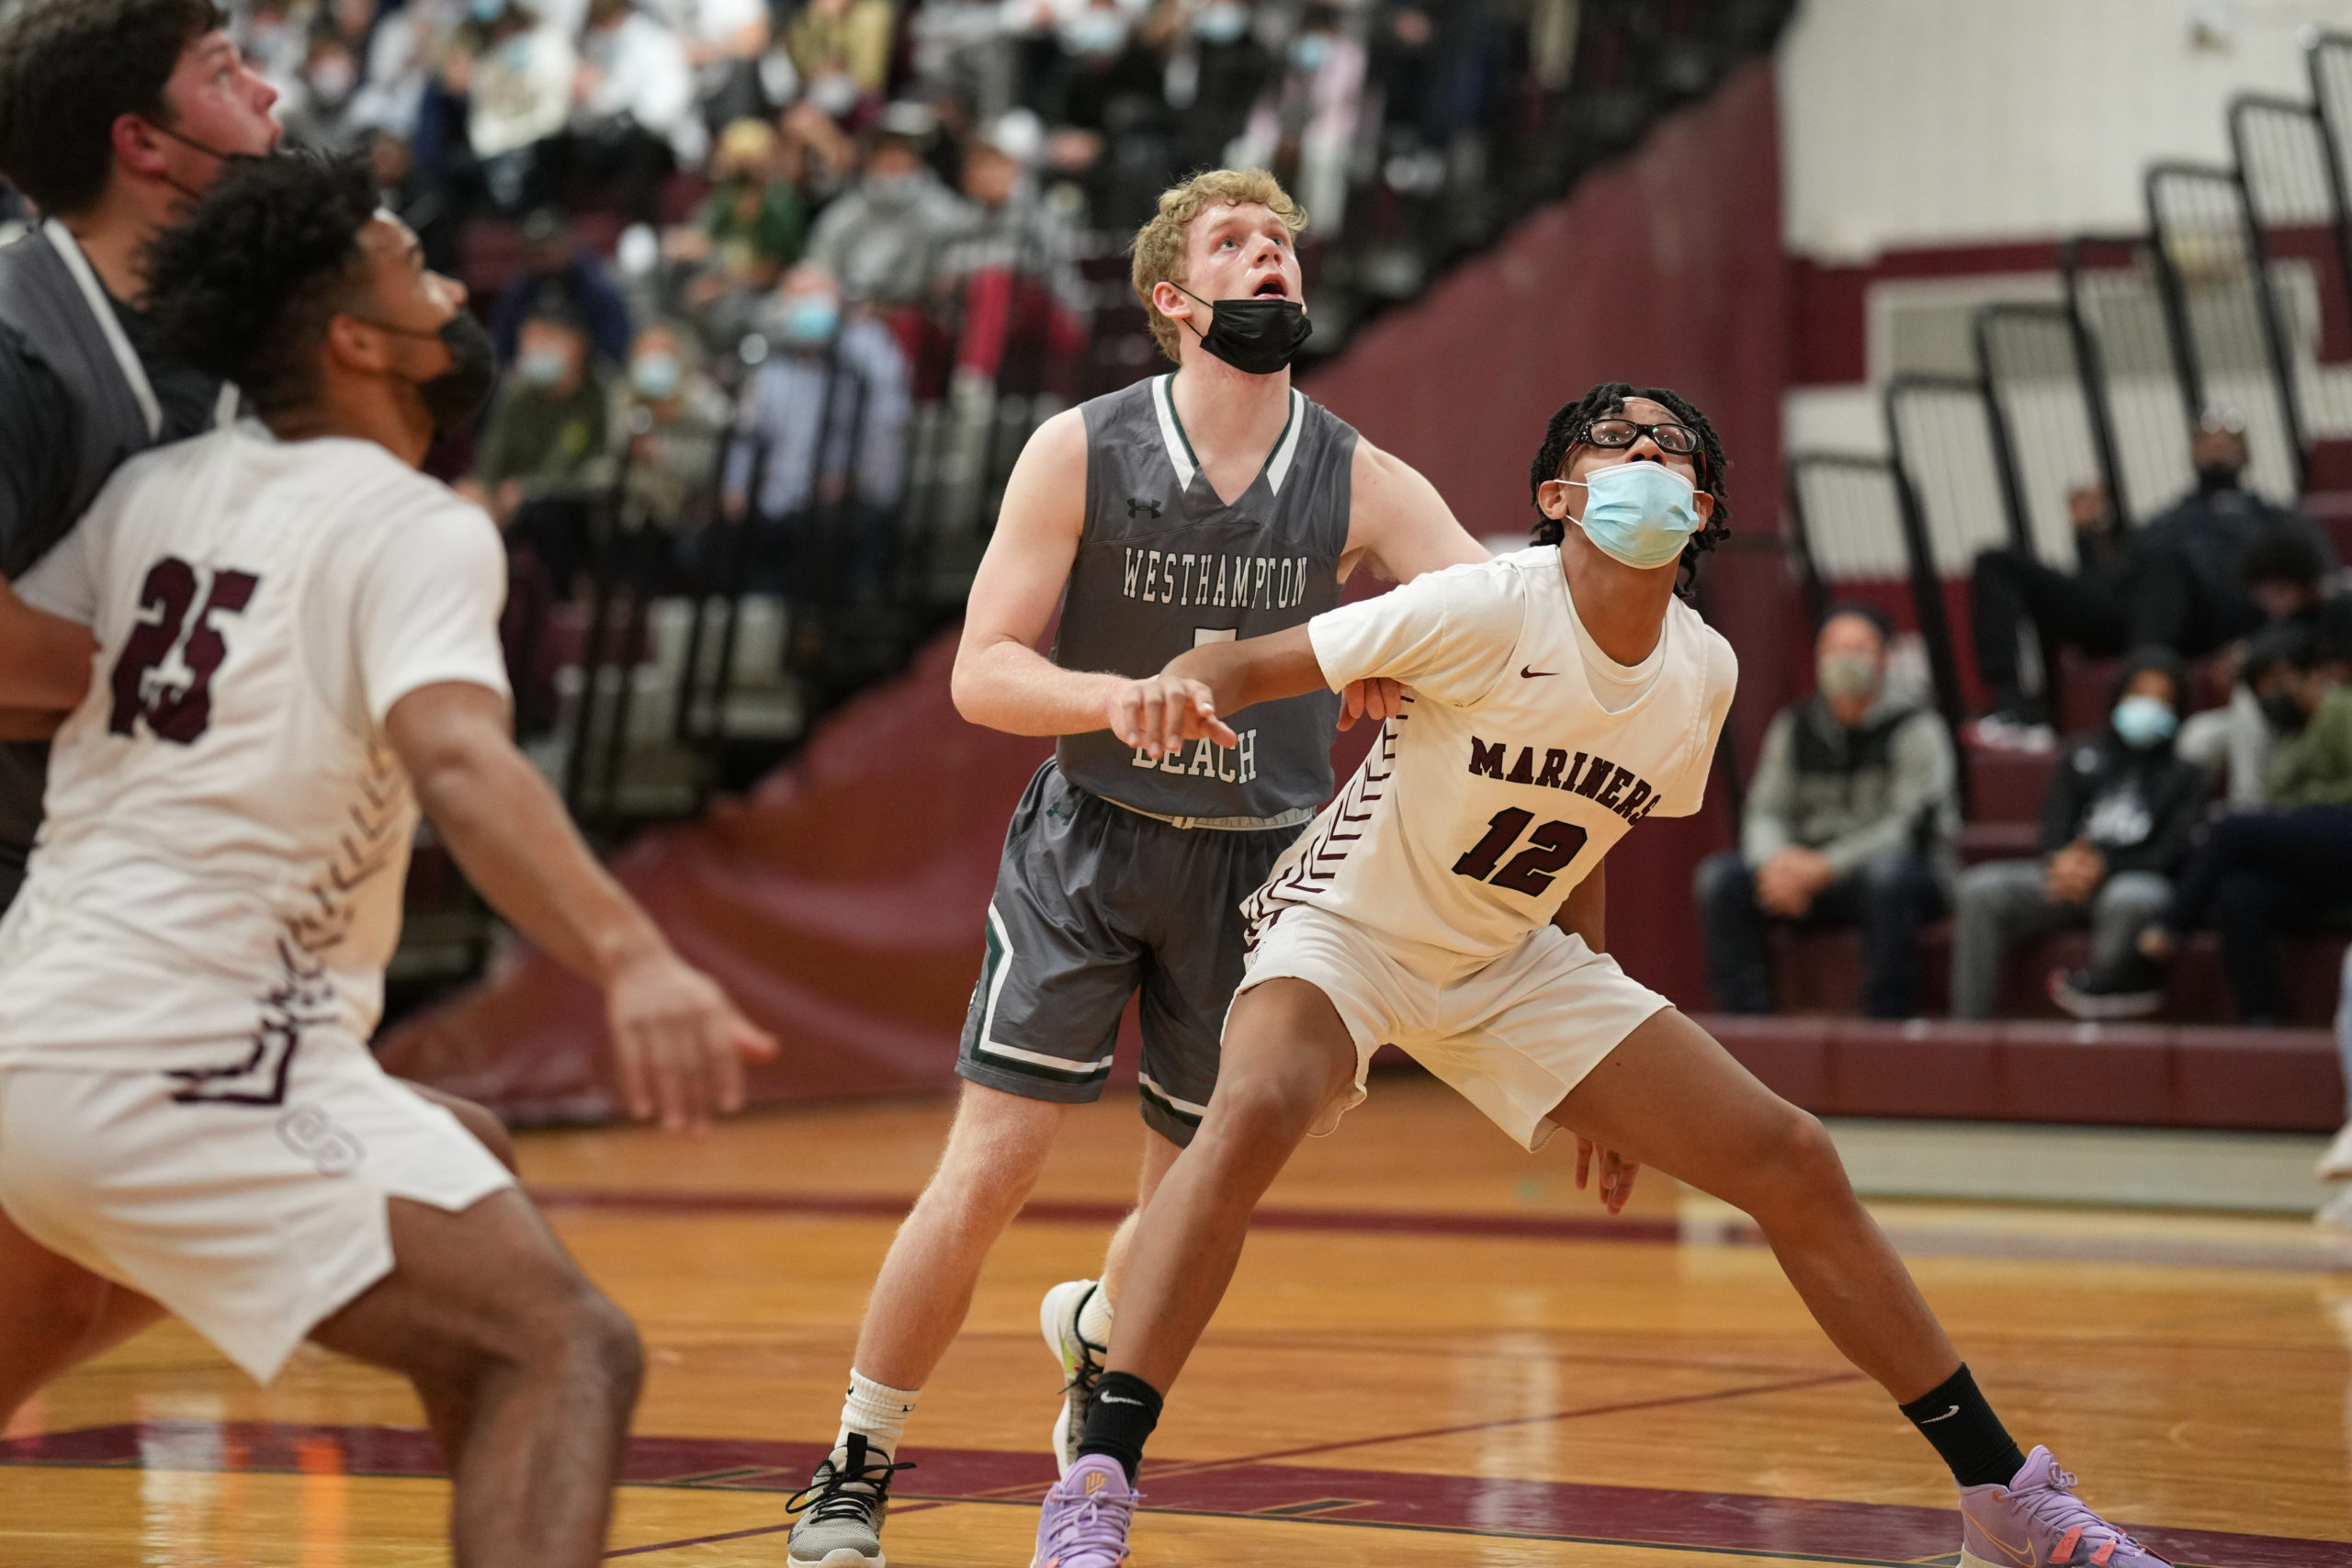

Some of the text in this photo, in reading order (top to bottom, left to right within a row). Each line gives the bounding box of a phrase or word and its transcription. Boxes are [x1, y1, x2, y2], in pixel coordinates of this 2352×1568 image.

[1123, 547, 1308, 611] WESTHAMPTON
[108, 556, 260, 746] 25
[1468, 735, 1662, 827] MARINERS
[1452, 807, 1589, 898] 12
